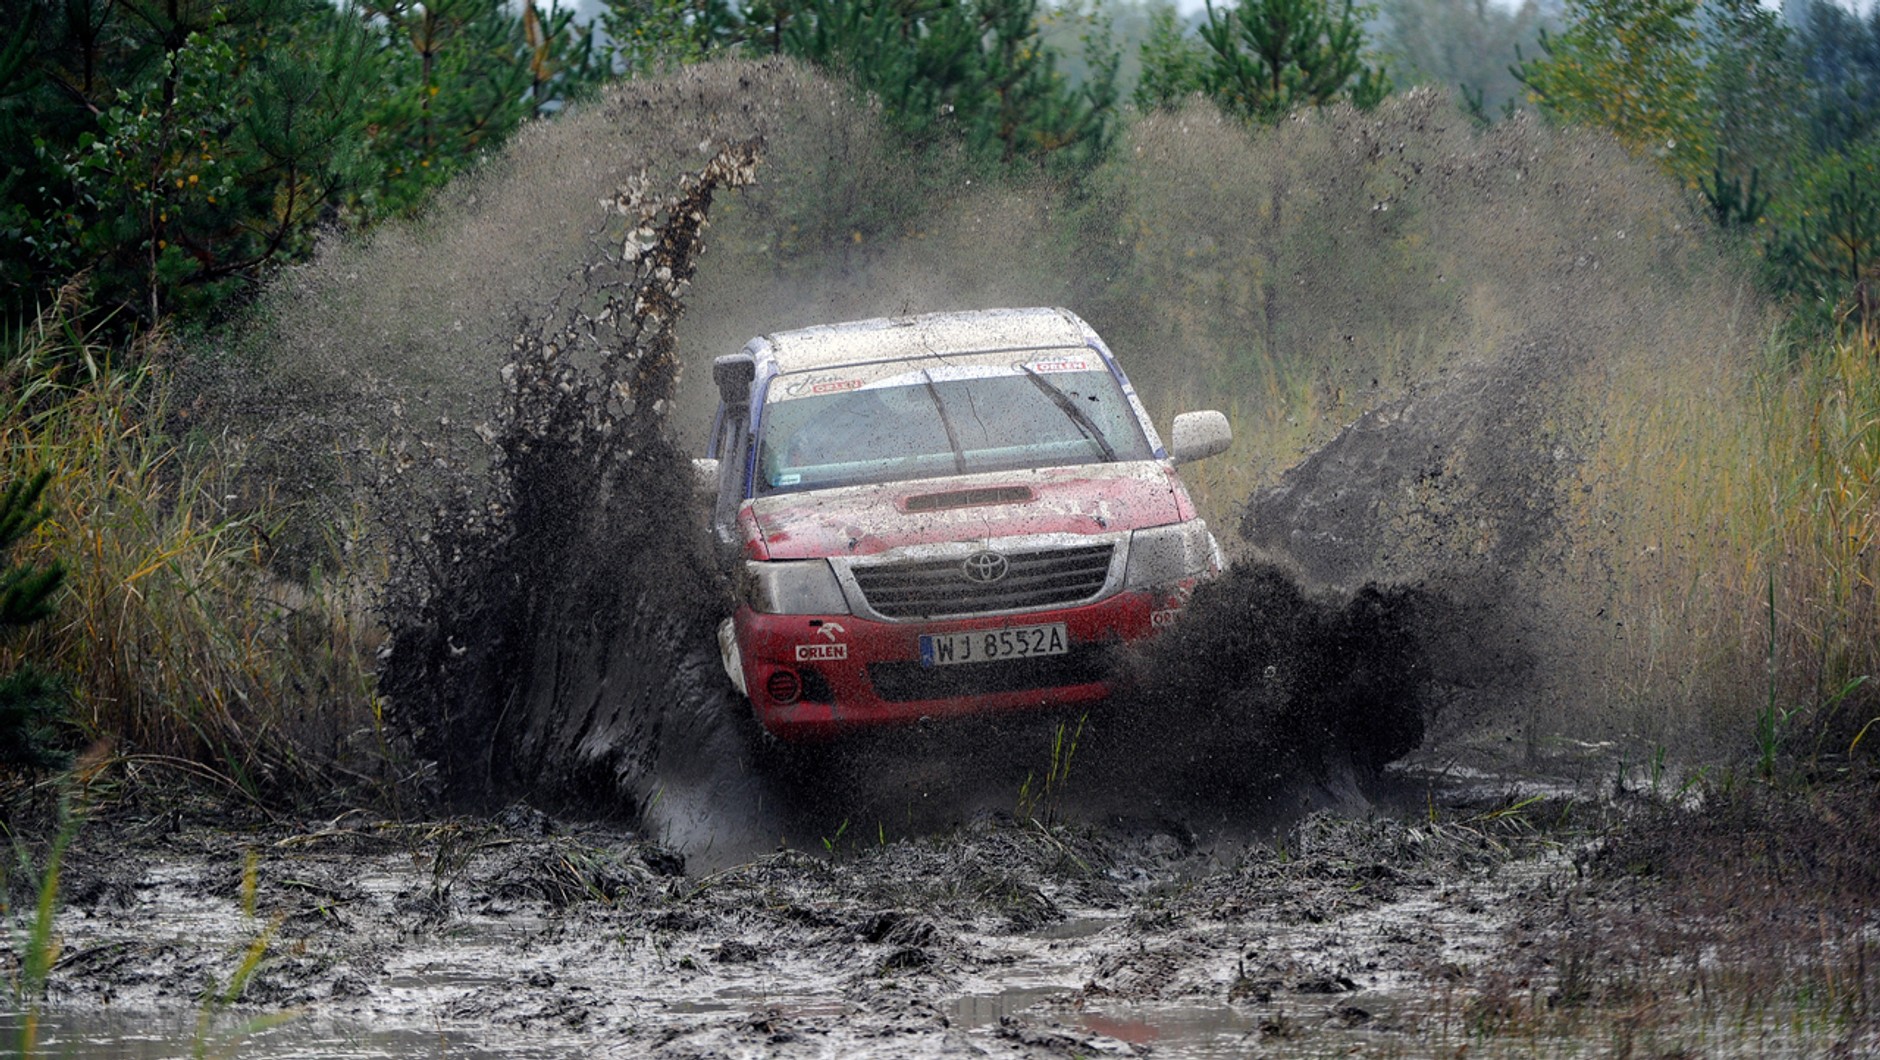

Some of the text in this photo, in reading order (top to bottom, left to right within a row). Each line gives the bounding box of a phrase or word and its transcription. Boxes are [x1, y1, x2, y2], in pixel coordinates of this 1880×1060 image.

[1037, 361, 1086, 372] ORLEN
[813, 380, 862, 393] ORLEN
[937, 636, 971, 662] WJ
[984, 626, 1063, 658] 8552A
[798, 646, 843, 659] ORLEN
